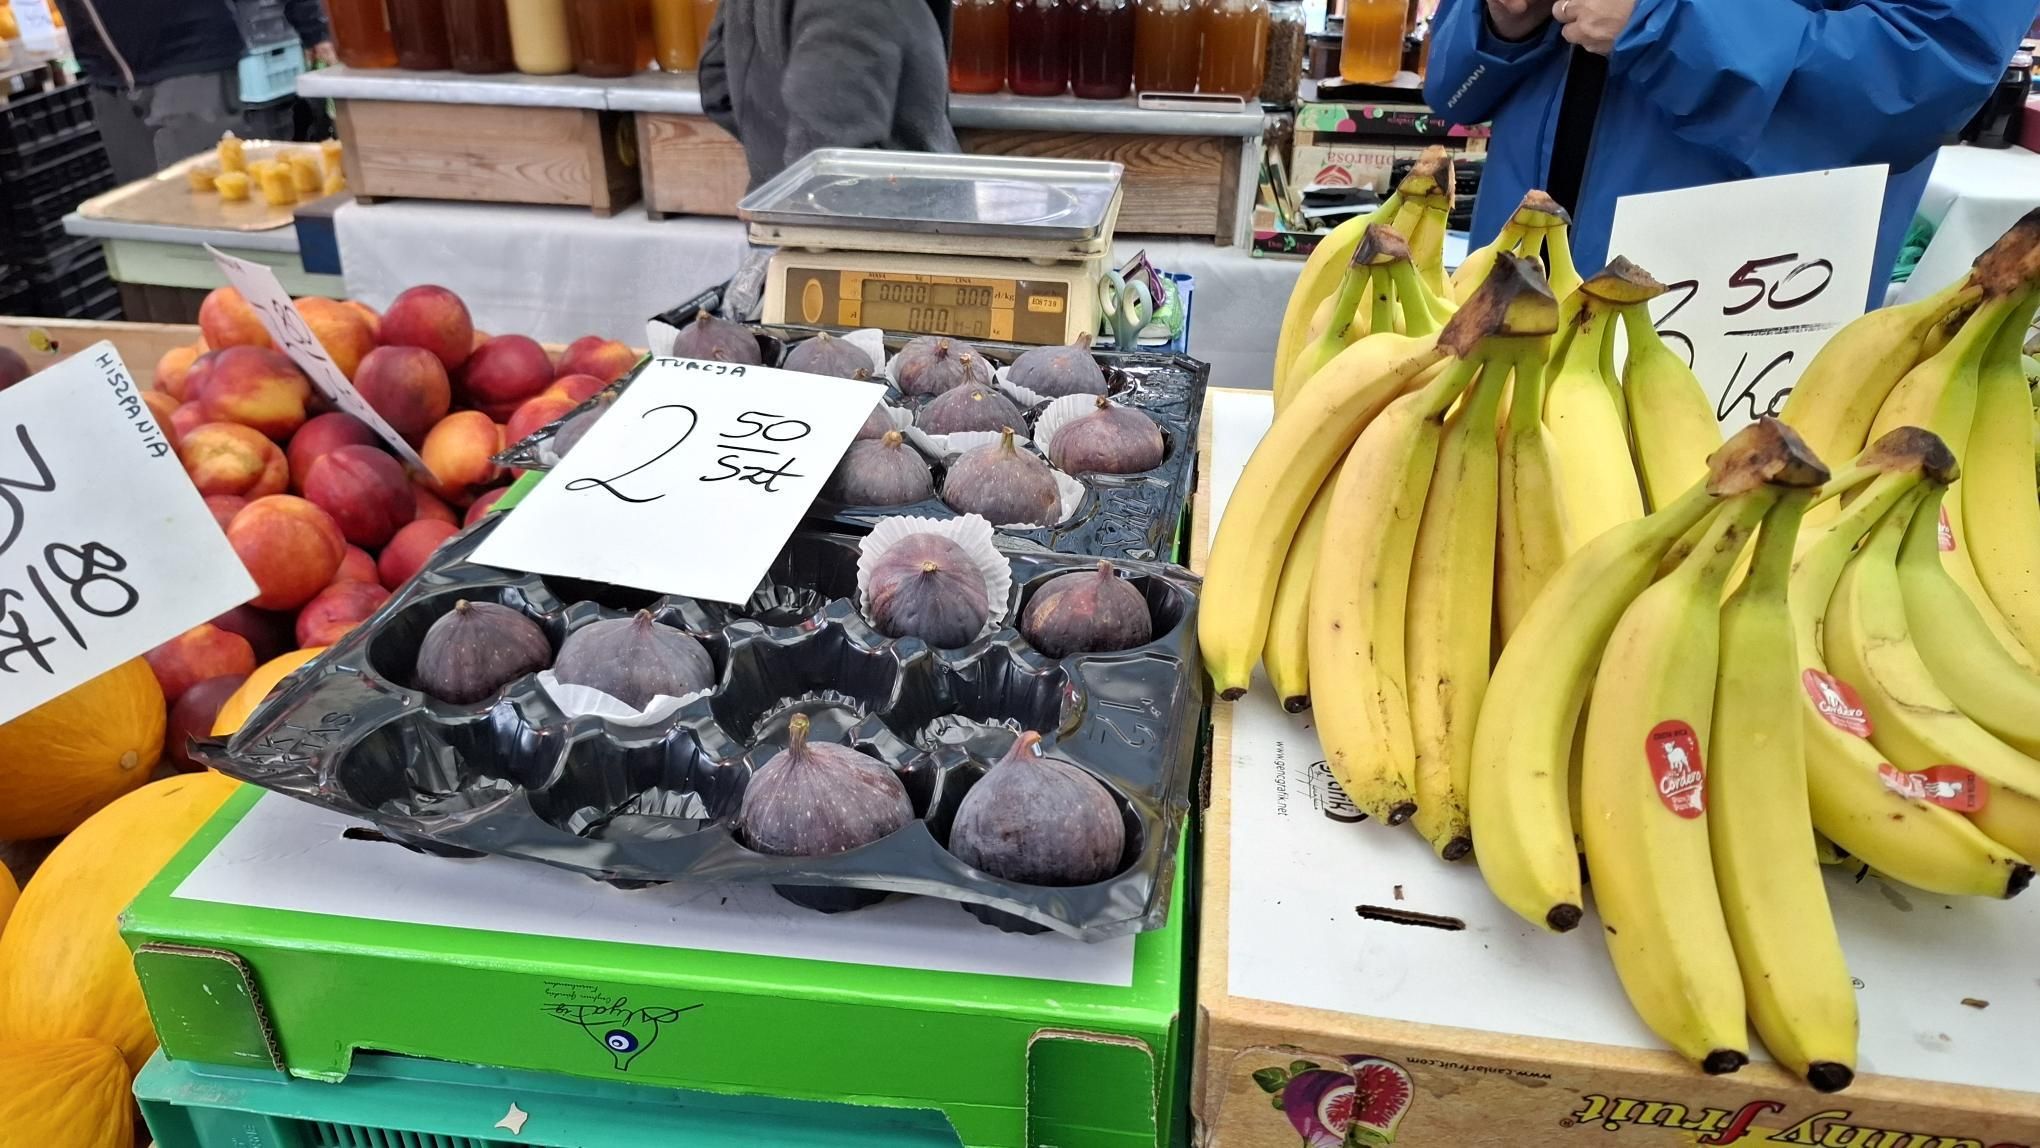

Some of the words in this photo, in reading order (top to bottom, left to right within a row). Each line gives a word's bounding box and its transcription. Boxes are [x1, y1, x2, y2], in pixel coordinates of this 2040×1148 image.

[1723, 253, 1833, 315] 50
[564, 403, 698, 504] 2
[718, 410, 811, 442] 50
[44, 541, 140, 618] 80
[1660, 770, 1702, 794] Cordero
[1572, 1094, 1784, 1146] fruit
